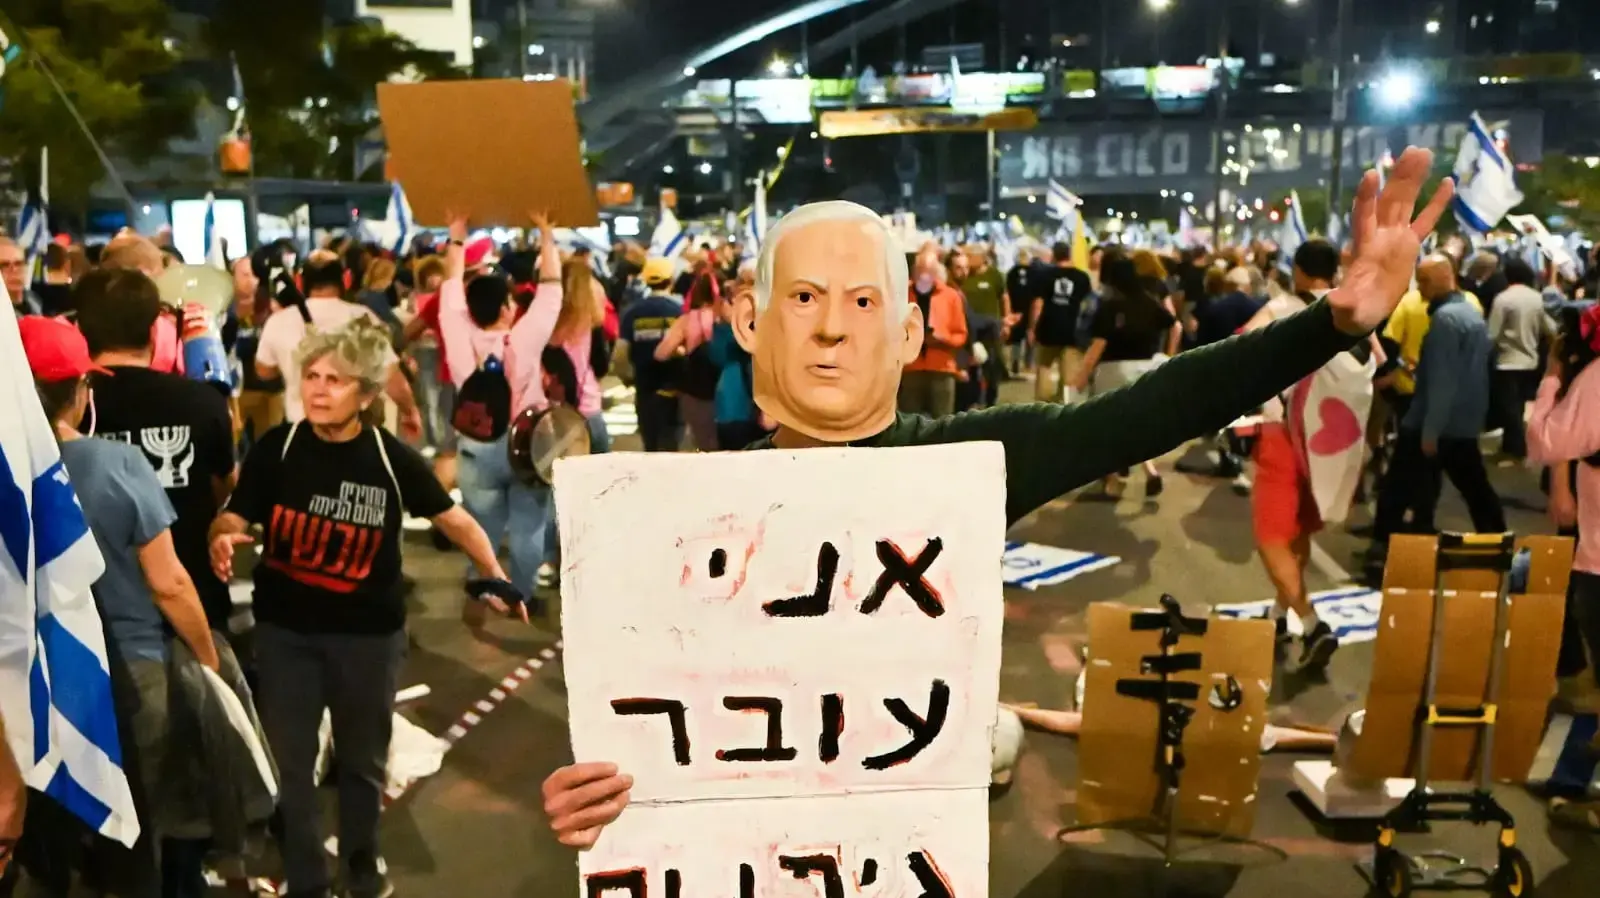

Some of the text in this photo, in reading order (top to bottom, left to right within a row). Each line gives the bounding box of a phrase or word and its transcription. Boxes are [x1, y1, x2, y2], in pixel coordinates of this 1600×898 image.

[270, 503, 384, 580] עכשיו
[308, 494, 385, 527] אותם הביתה
[708, 536, 945, 618] אני
[610, 678, 950, 770] עובר
